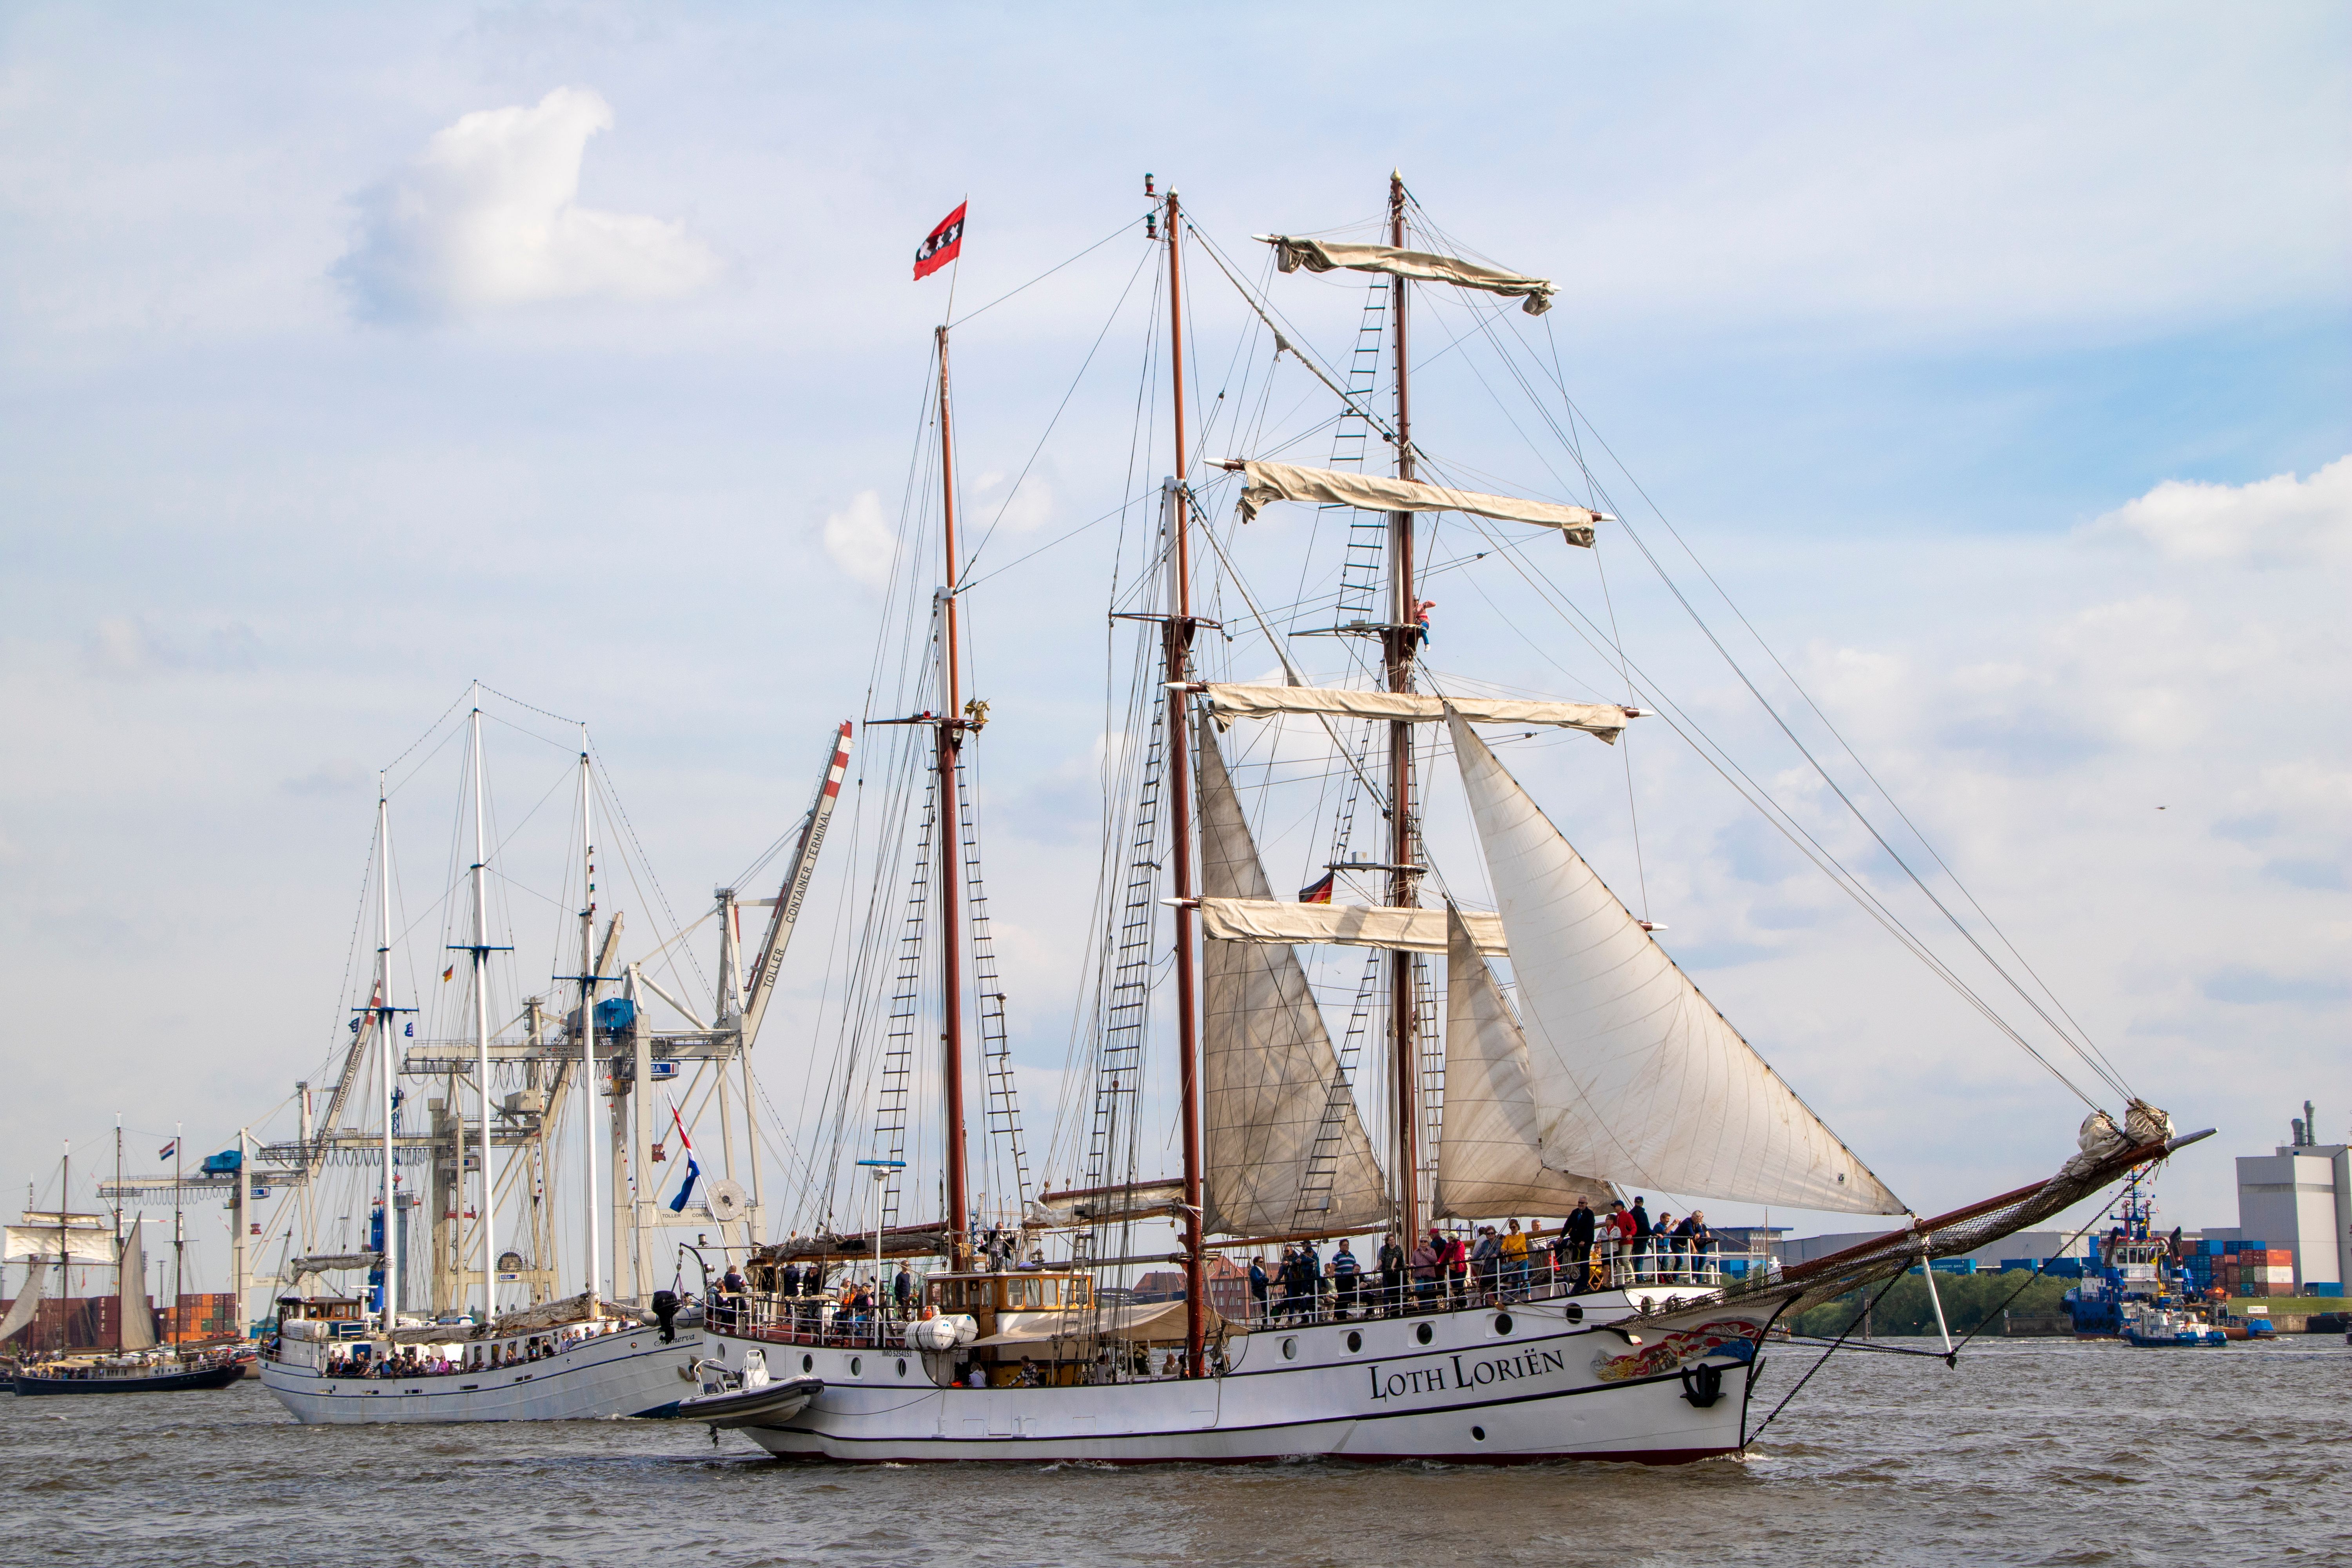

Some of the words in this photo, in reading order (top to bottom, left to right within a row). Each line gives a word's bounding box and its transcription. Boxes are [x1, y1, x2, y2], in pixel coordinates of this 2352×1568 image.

[764, 948, 784, 987] TOLLER
[786, 866, 813, 923] CONTAINER
[806, 810, 831, 861] TERMINAL
[335, 1075, 352, 1112] CONTAINER
[348, 1042, 365, 1073] TERMINAL
[1368, 1365, 1447, 1403] LOTH
[1449, 1348, 1564, 1392] LORIËN
